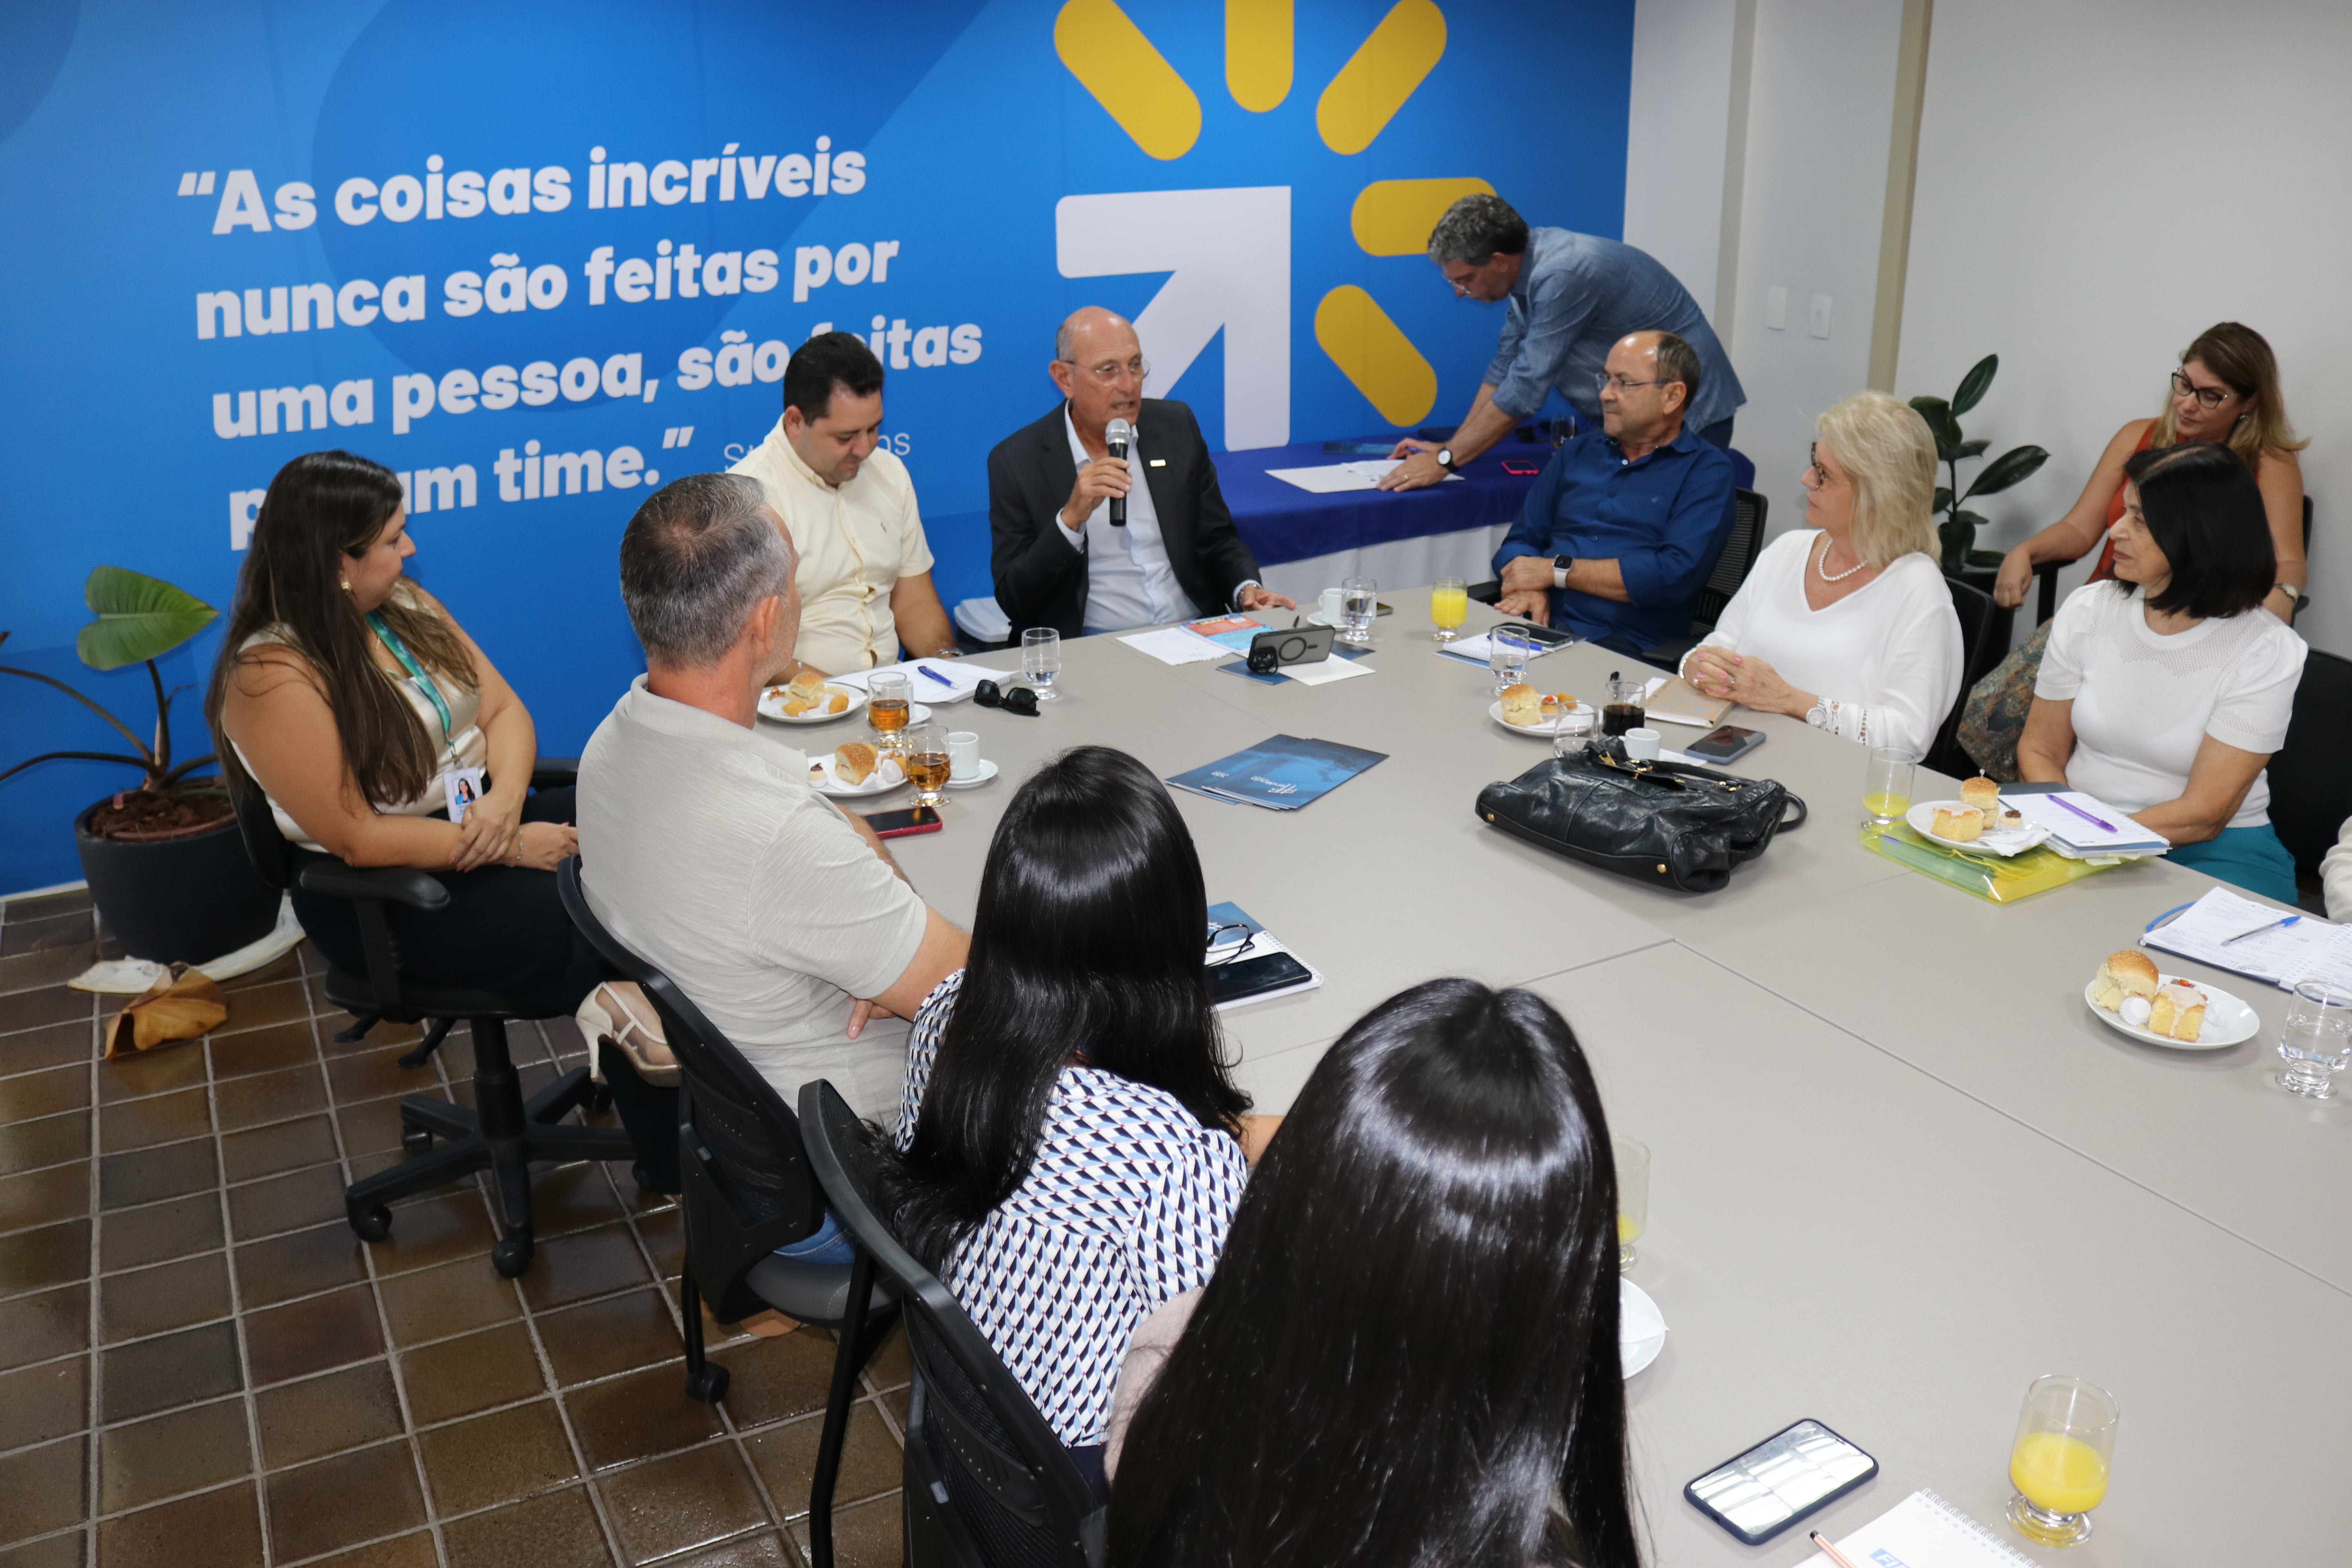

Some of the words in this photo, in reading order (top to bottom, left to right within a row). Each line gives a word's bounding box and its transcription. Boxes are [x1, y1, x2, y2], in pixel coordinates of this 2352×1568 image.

[335, 155, 572, 225] coisas
[589, 136, 866, 209] incríveis
[196, 275, 425, 339] nunca
[444, 253, 568, 317] são
[584, 240, 779, 305] feitas
[793, 240, 900, 303] por
[213, 379, 374, 439] uma
[393, 353, 659, 434] pessoa,
[677, 330, 790, 390] são
[806, 315, 982, 369] itas
[1875, 1553, 1909, 1568] FI
